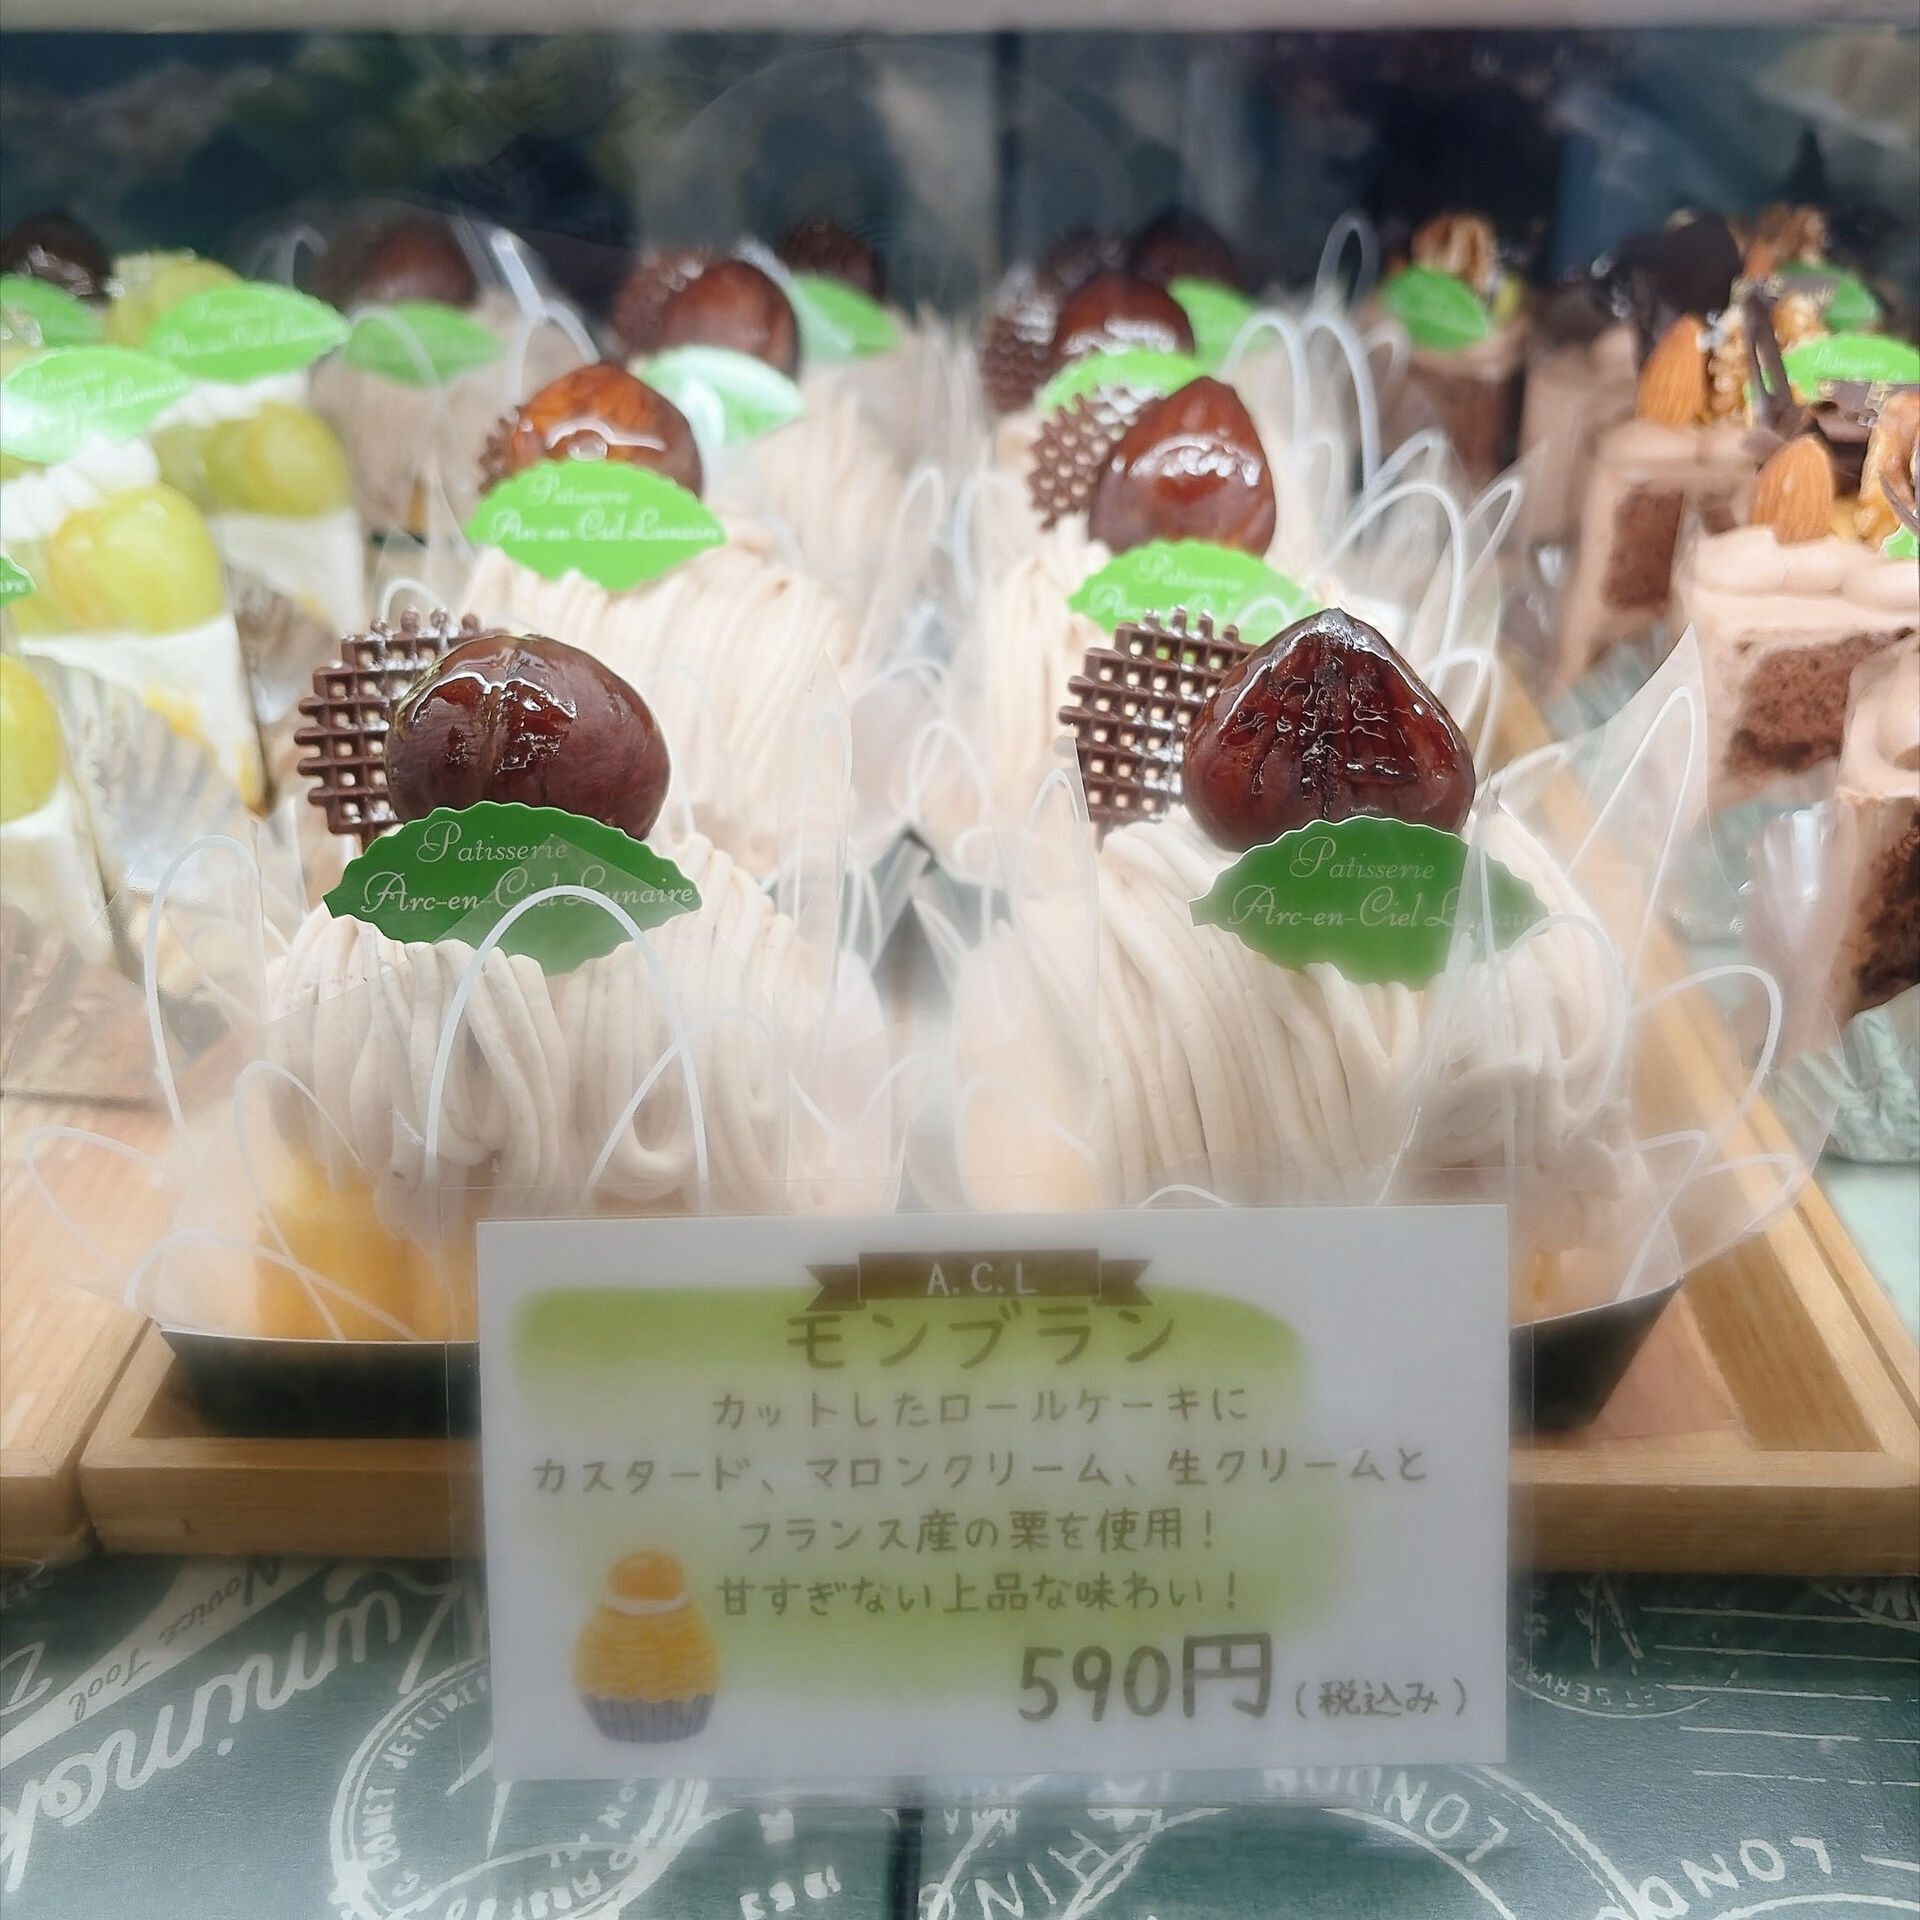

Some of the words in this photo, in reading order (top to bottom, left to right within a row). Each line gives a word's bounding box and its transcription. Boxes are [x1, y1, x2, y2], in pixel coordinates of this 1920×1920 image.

[416, 820, 568, 864] Patisserie
[1289, 836, 1434, 880] Patisserie
[1227, 884, 1422, 928] Arc-en-Ciel
[787, 1303, 1174, 1370] モンブラン
[712, 1386, 1248, 1430] カットしたロールケーキに
[533, 1448, 1427, 1494] カスタード、マロンクリーム、生クリームと
[740, 1507, 1215, 1554] フランス産の栗を使用！
[716, 1570, 1238, 1615] 甘すぎない上品な味わい！
[1018, 1632, 1273, 1722] 590円
